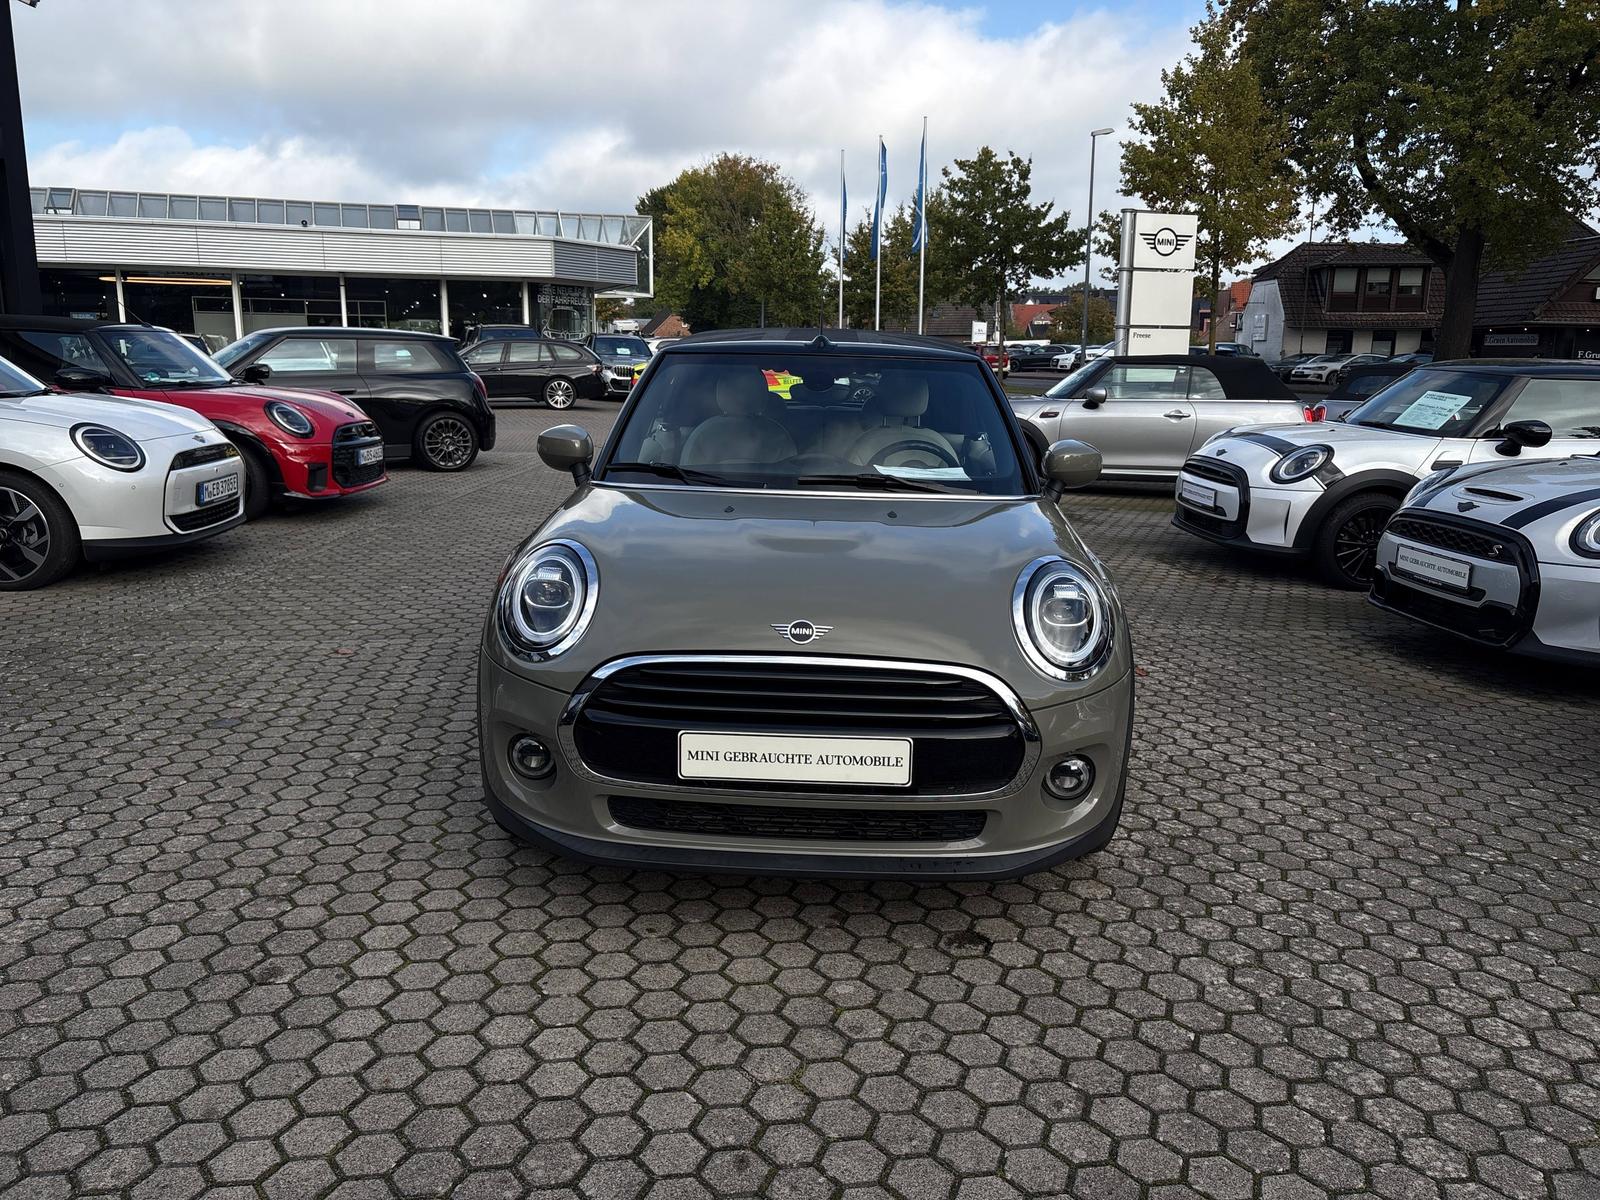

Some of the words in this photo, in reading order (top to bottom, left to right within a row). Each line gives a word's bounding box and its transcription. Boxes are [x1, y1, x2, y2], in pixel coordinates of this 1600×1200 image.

[1157, 238, 1175, 247] MINI
[1132, 331, 1152, 339] Freese
[1437, 566, 1467, 578] AUTOMOBILE
[791, 627, 813, 636] MINI
[687, 750, 720, 762] MINI
[723, 751, 812, 765] GEBRAUCHTE
[816, 754, 904, 768] AUTOMOBILE
